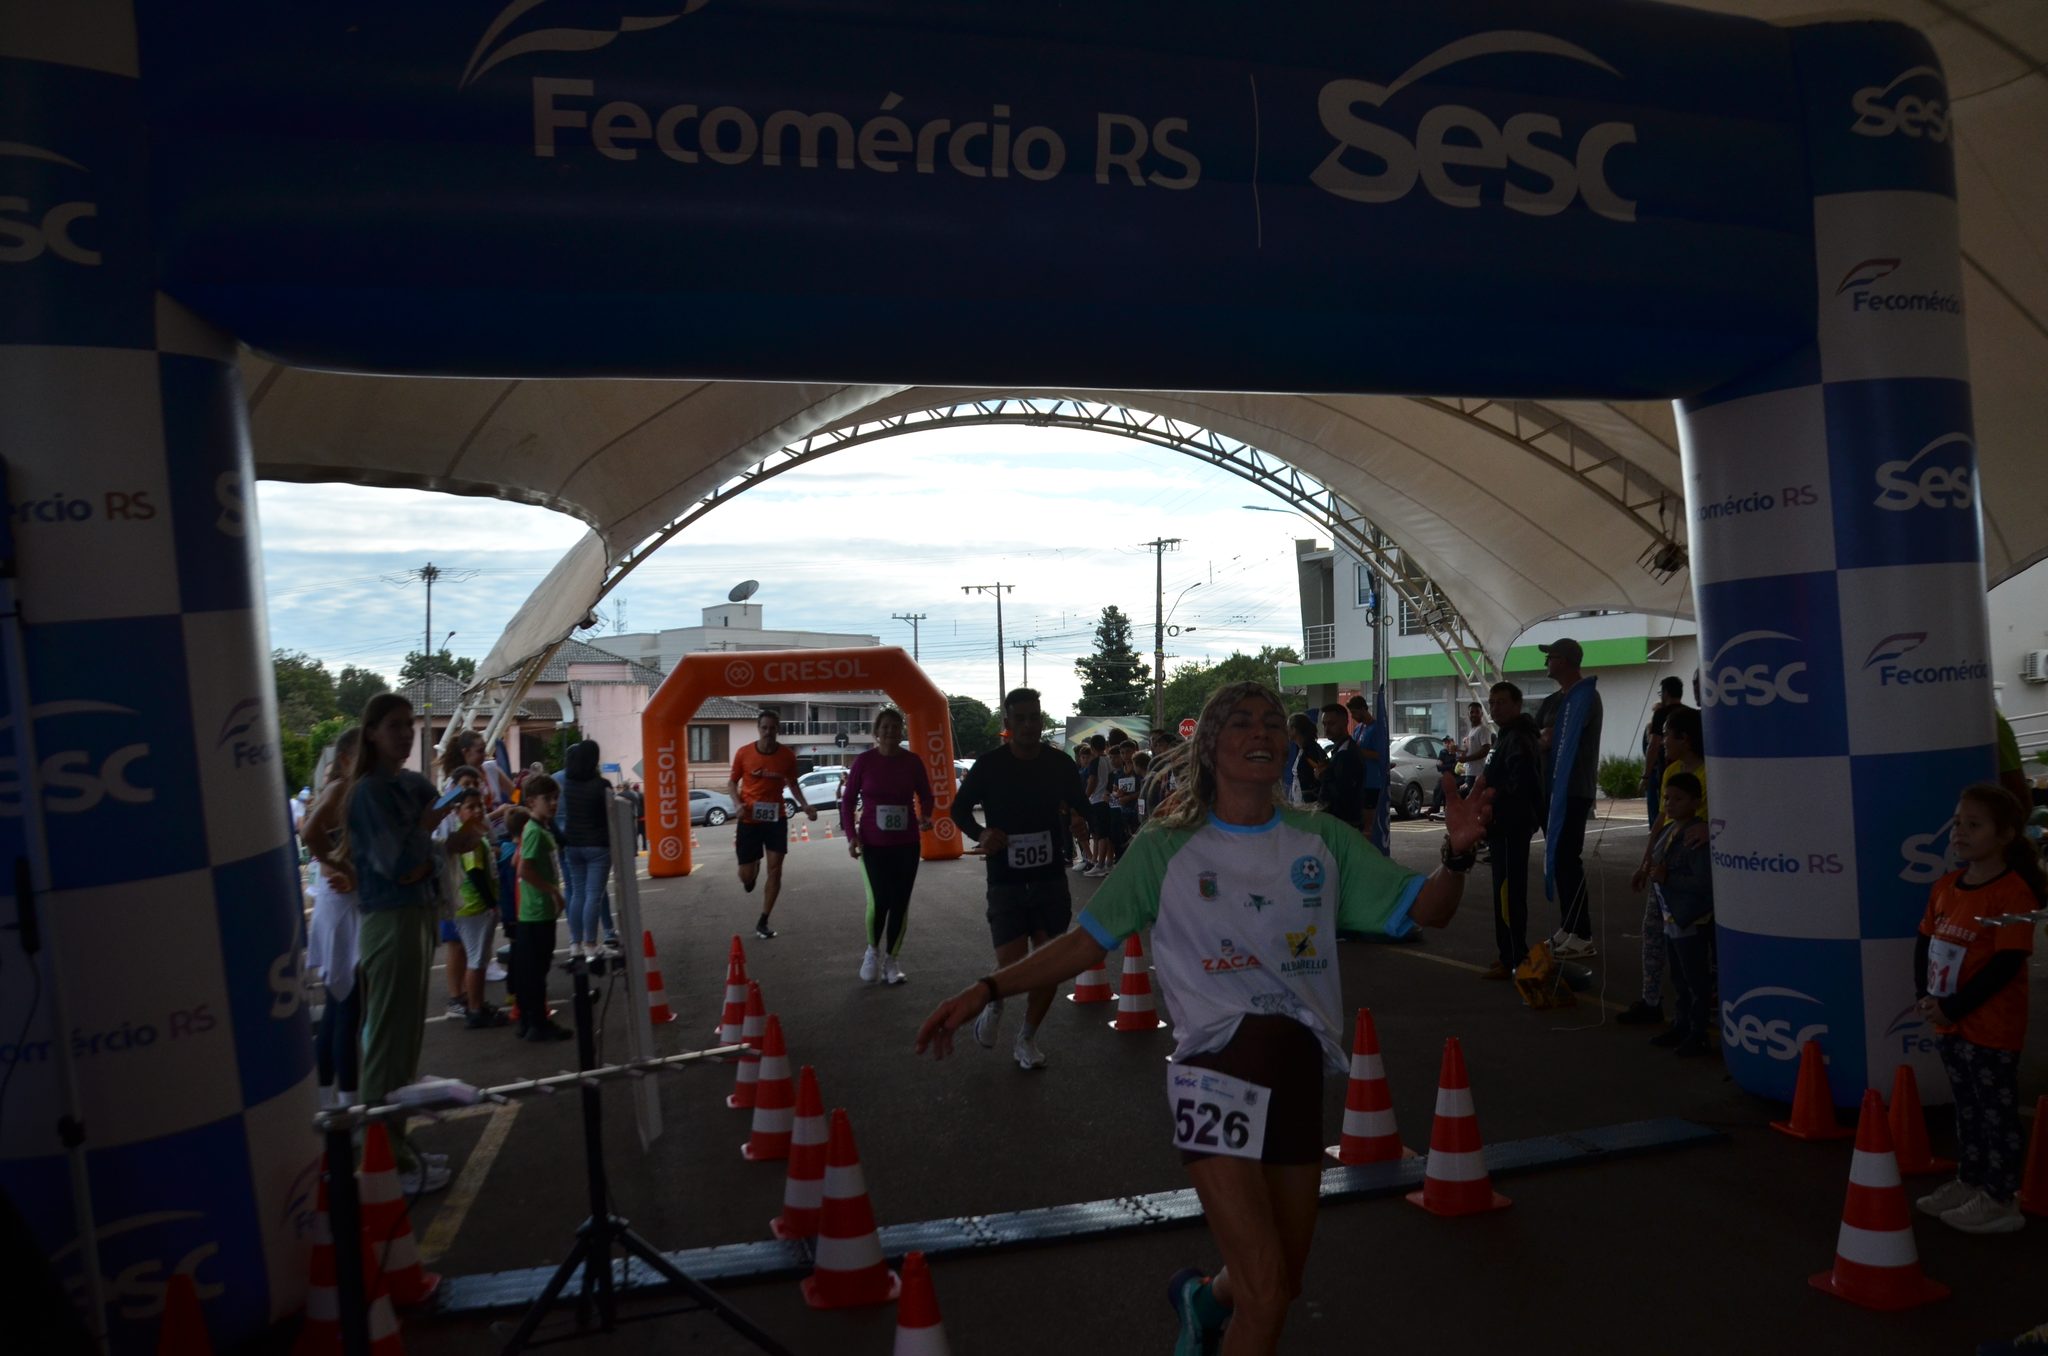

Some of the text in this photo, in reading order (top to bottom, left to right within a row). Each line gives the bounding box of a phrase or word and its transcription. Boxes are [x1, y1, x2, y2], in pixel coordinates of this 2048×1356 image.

[532, 76, 1201, 190] Fecomércio RS
[1309, 77, 1638, 223] Sesc
[105, 491, 156, 521] RS
[1782, 484, 1819, 508] RS
[763, 656, 870, 683] CRESOL
[928, 722, 950, 811] CRESOL
[657, 739, 679, 830] CRESOL
[755, 808, 775, 820] 583
[885, 814, 901, 828] 88
[1015, 844, 1048, 866] 505
[1808, 854, 1843, 874] RS
[1201, 954, 1262, 971] ZACA
[169, 1005, 216, 1040] RS
[1176, 1097, 1250, 1151] 526
